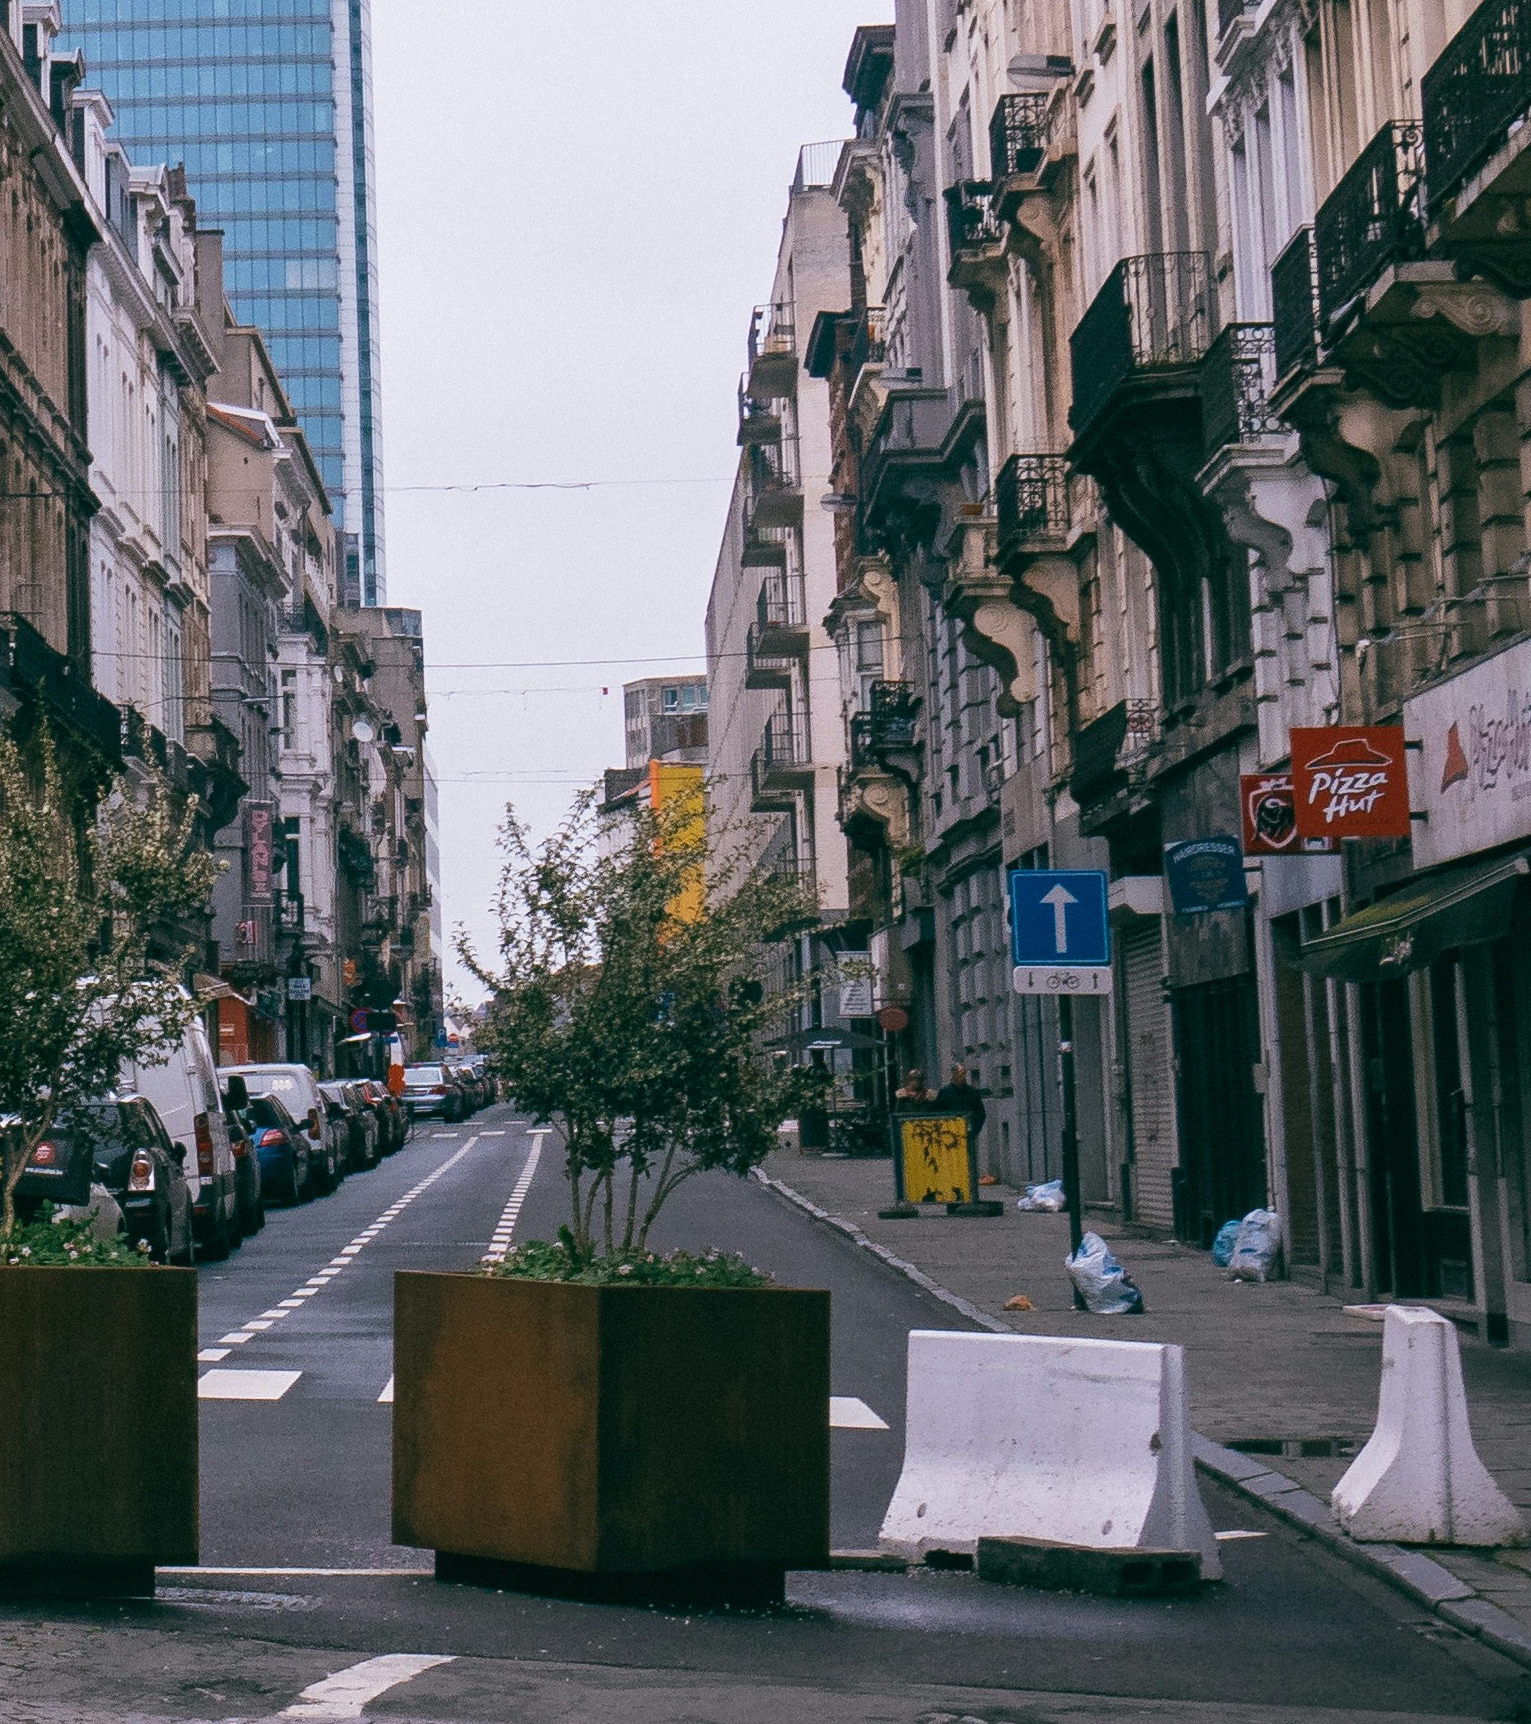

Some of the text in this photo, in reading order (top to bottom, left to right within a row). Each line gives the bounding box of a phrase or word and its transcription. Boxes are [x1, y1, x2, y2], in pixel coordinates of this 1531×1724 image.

[1308, 768, 1388, 804] Pizza
[1323, 789, 1385, 823] Hut
[1172, 842, 1235, 864] HAIRDRESSER
